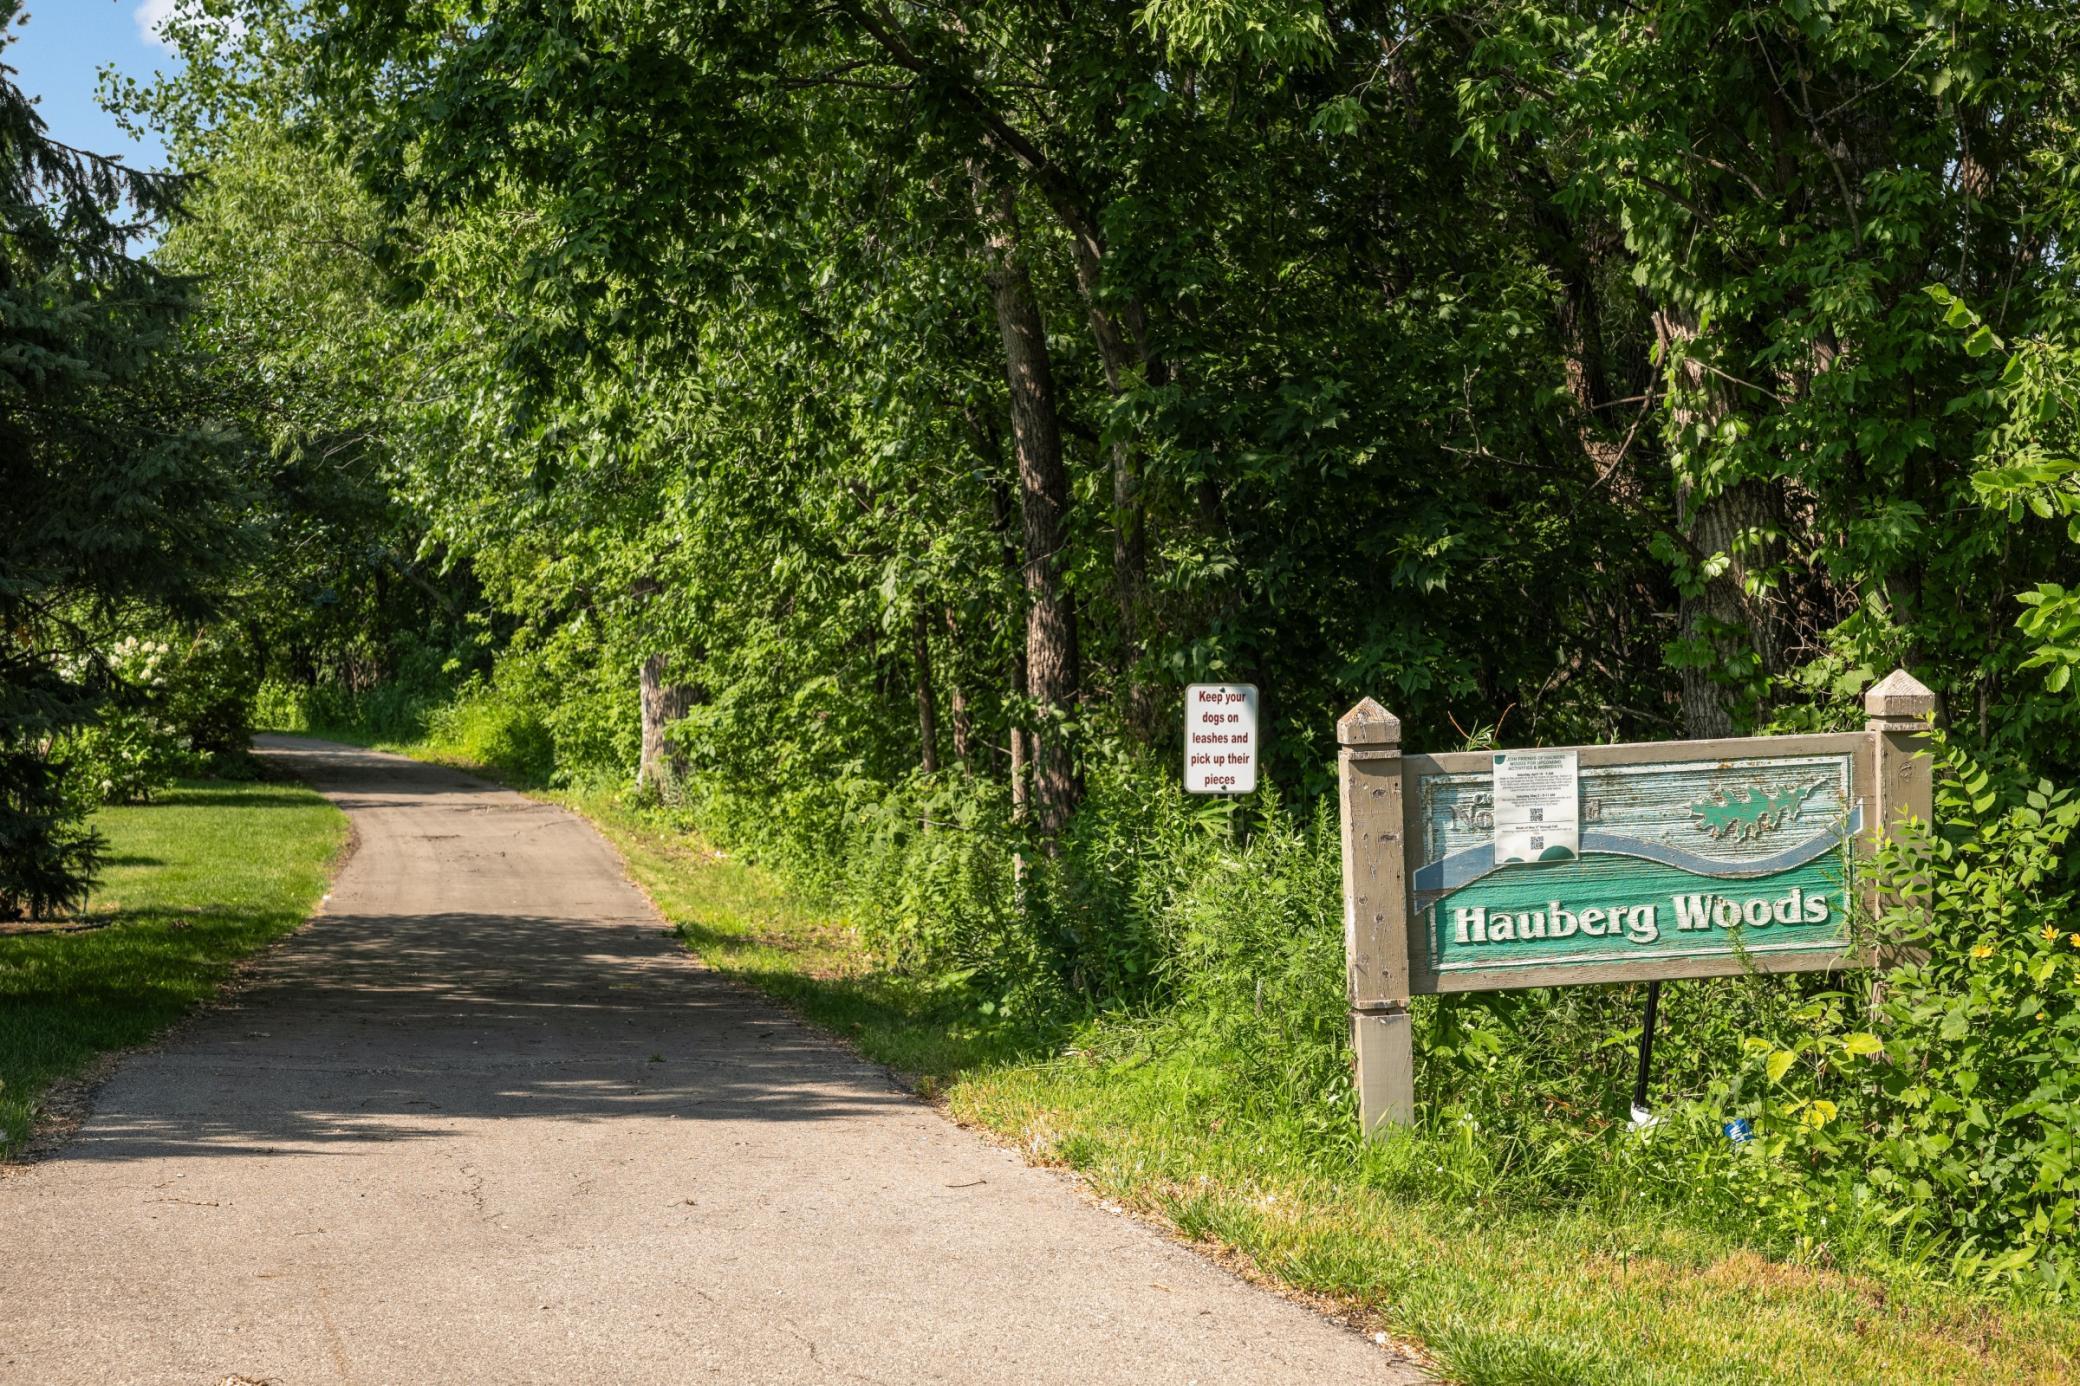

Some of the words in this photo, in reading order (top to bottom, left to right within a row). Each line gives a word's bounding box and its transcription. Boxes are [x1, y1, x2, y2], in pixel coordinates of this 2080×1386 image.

[1199, 691, 1223, 704] Keep
[1225, 693, 1246, 705] your
[1202, 712, 1224, 725] dogs
[1227, 714, 1239, 723] on
[1192, 732, 1228, 743] leashes
[1231, 732, 1248, 743] and
[1191, 753, 1210, 767] pick
[1213, 756, 1225, 767] up
[1228, 753, 1250, 764] their
[1204, 773, 1235, 787] pieces
[1455, 900, 1660, 943] Hauberg
[1671, 888, 1829, 930] Woods
